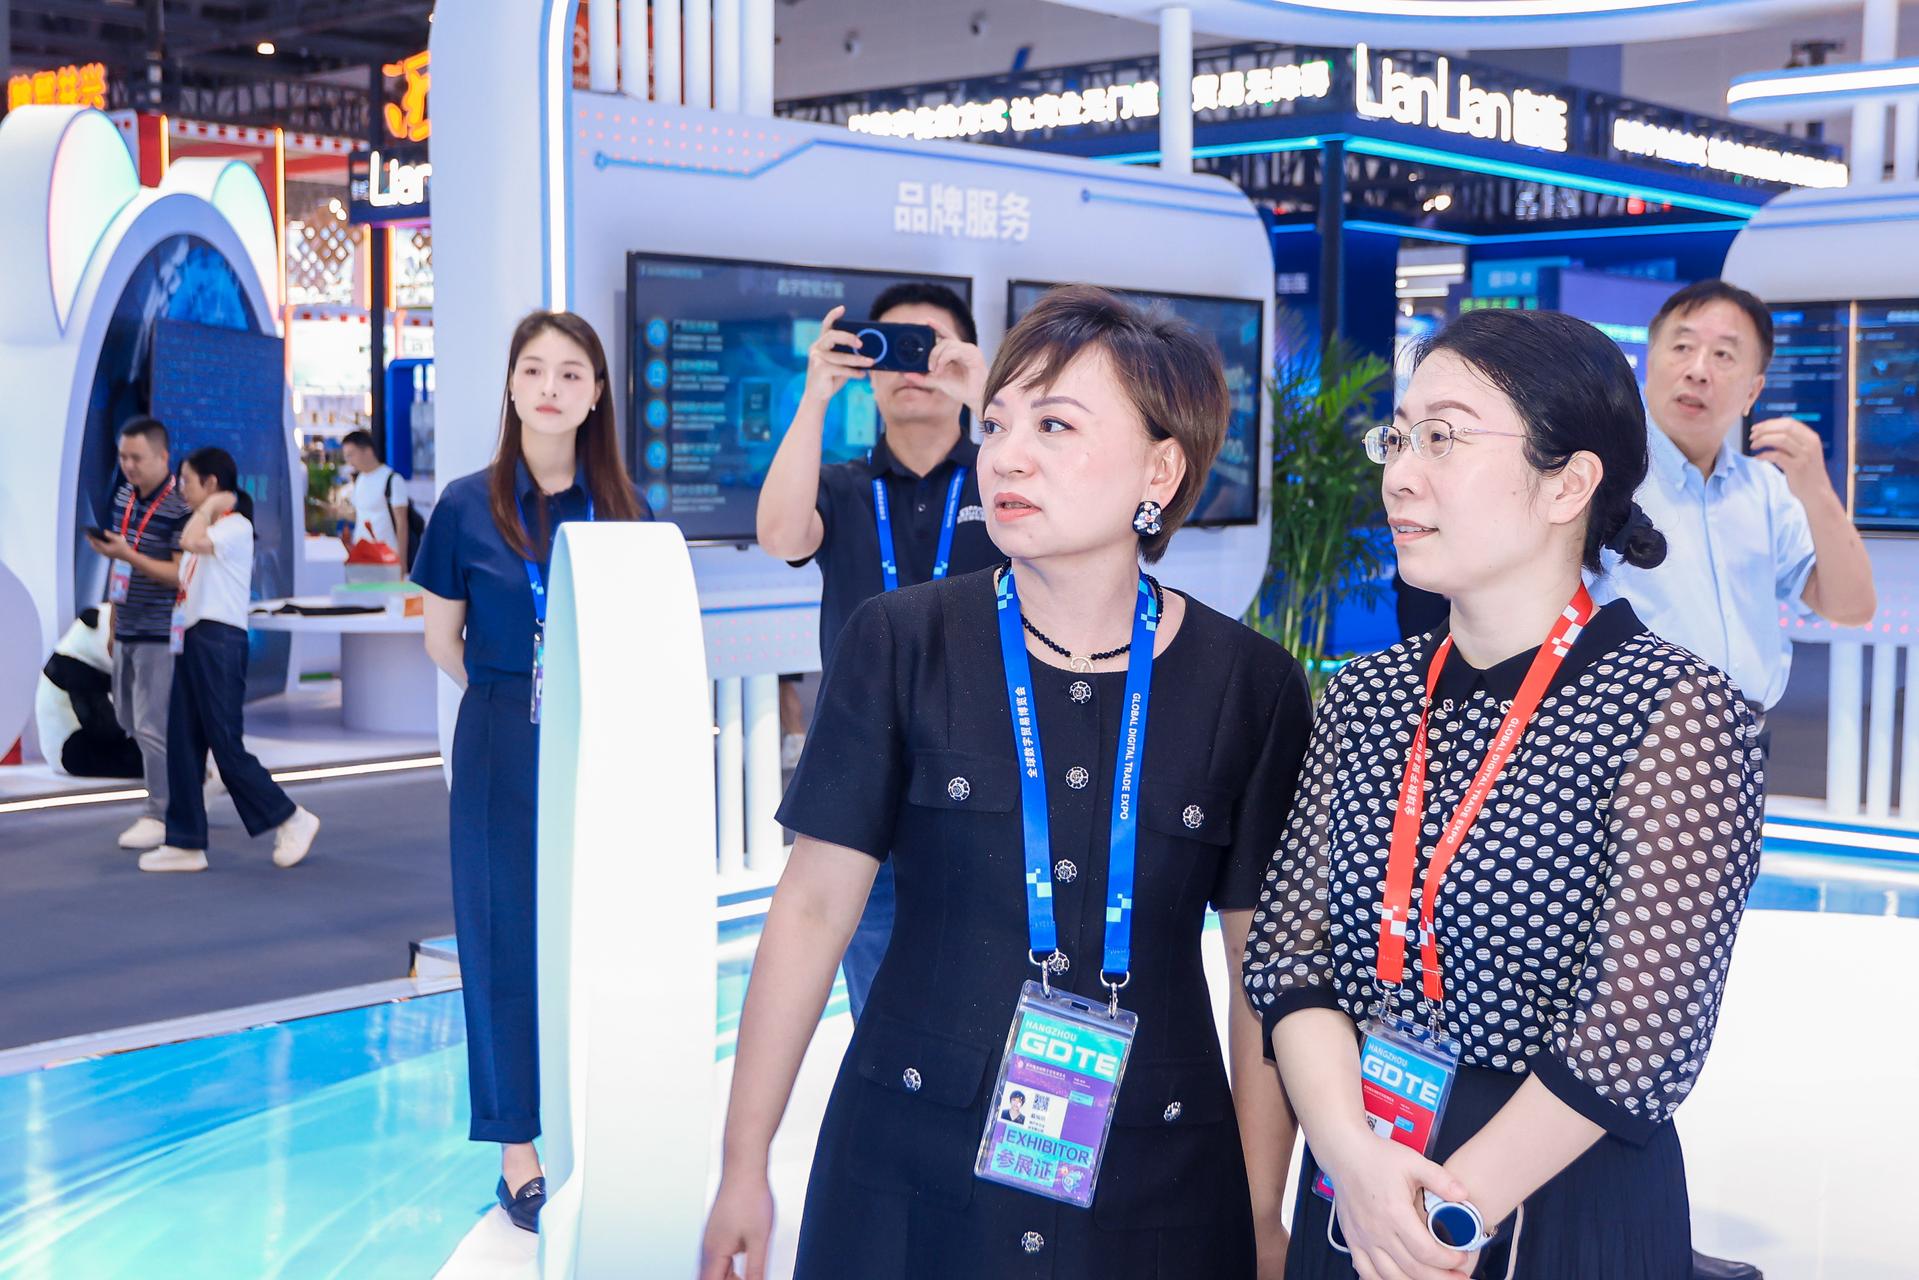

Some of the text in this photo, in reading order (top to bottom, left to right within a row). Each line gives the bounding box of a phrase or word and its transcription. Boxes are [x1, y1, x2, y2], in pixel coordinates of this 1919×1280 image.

[894, 181, 1031, 242] 品牌服务
[1015, 686, 1038, 778] 全球数字贸易博览会
[1119, 692, 1141, 820] GLOBAL DIGITAL TRADE EXPO
[1446, 717, 1519, 844] GLOBAL DIGITAL TRADE EXPO
[1020, 1031, 1118, 1077] GDTE
[1025, 1020, 1077, 1042] HANGZHOU
[1362, 1054, 1440, 1105] GDTE
[1368, 1043, 1408, 1068] HANGZHOU
[996, 1148, 1053, 1181] 参展证
[1006, 1129, 1090, 1165] EXHIBITOR
